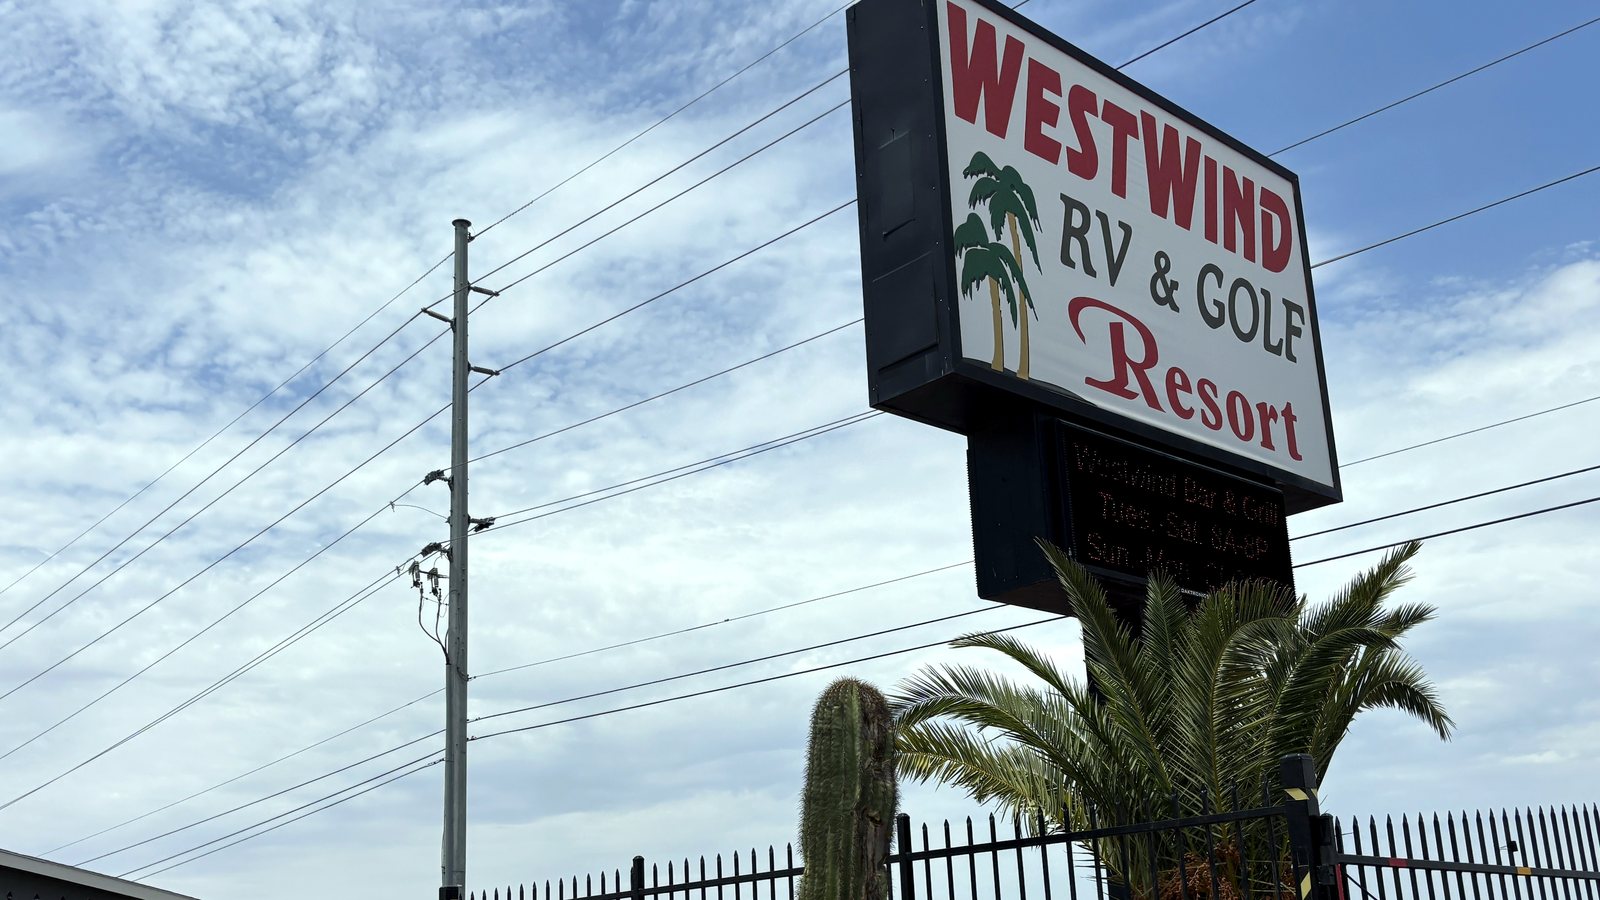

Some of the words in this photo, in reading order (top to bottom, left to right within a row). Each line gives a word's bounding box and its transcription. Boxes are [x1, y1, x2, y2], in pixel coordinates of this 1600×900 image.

[947, 0, 1293, 274] WESTWIND
[1059, 192, 1133, 288] RV
[1150, 250, 1180, 314] &
[1196, 262, 1306, 364] GOLF
[1067, 296, 1304, 462] Resort
